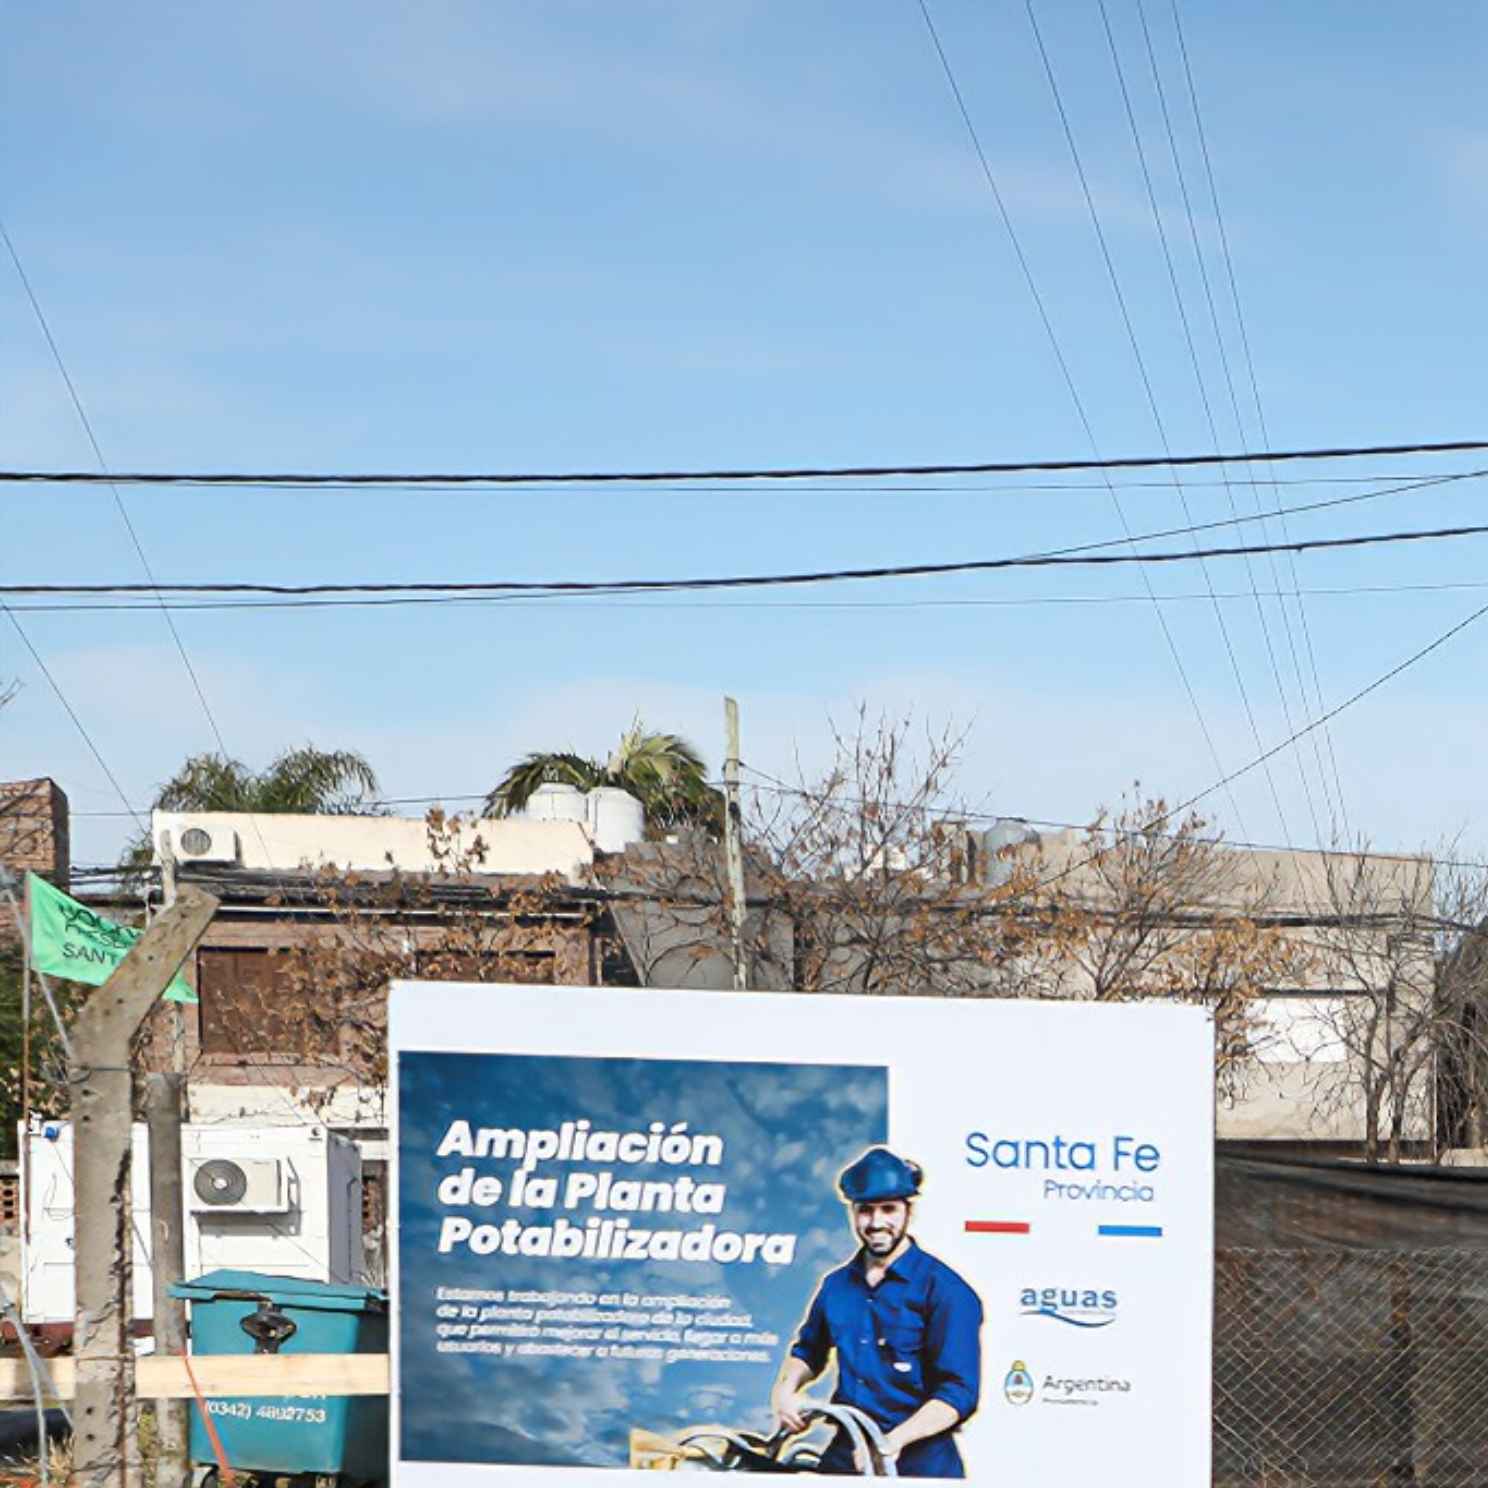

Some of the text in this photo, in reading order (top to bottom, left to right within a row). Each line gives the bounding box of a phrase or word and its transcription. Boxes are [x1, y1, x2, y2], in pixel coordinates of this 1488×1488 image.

[63, 943, 119, 966] SANT
[436, 1119, 724, 1171] Ampliación
[966, 1132, 1161, 1172] Santa Fe
[437, 1166, 726, 1213] de la Planta
[1044, 1179, 1155, 1202] Provincia
[438, 1216, 796, 1265] Potabilizadora
[1020, 1287, 1118, 1310] aguas
[1043, 1375, 1131, 1395] Argentina
[207, 1400, 251, 1420] (0342)
